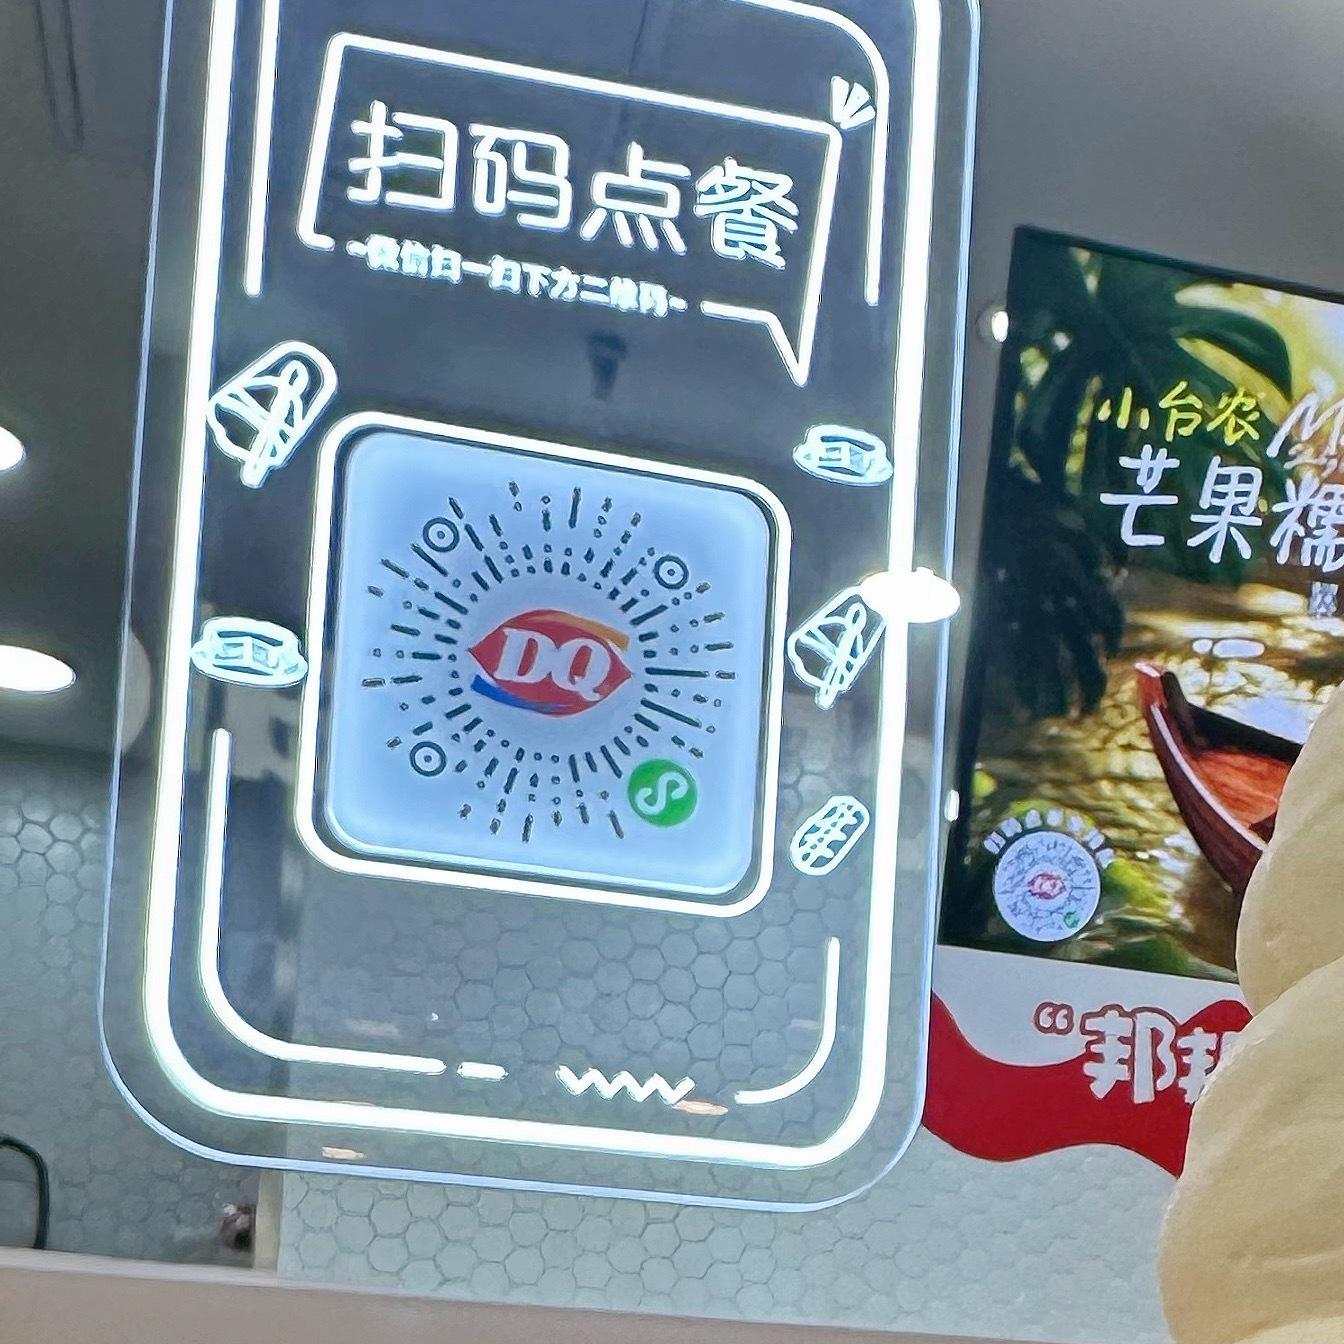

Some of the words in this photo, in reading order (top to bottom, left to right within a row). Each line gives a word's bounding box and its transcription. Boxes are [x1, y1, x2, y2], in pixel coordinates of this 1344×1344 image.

[346, 100, 800, 271] 扫码点餐
[1097, 380, 1262, 446] 小台农
[493, 628, 612, 702] DQ
